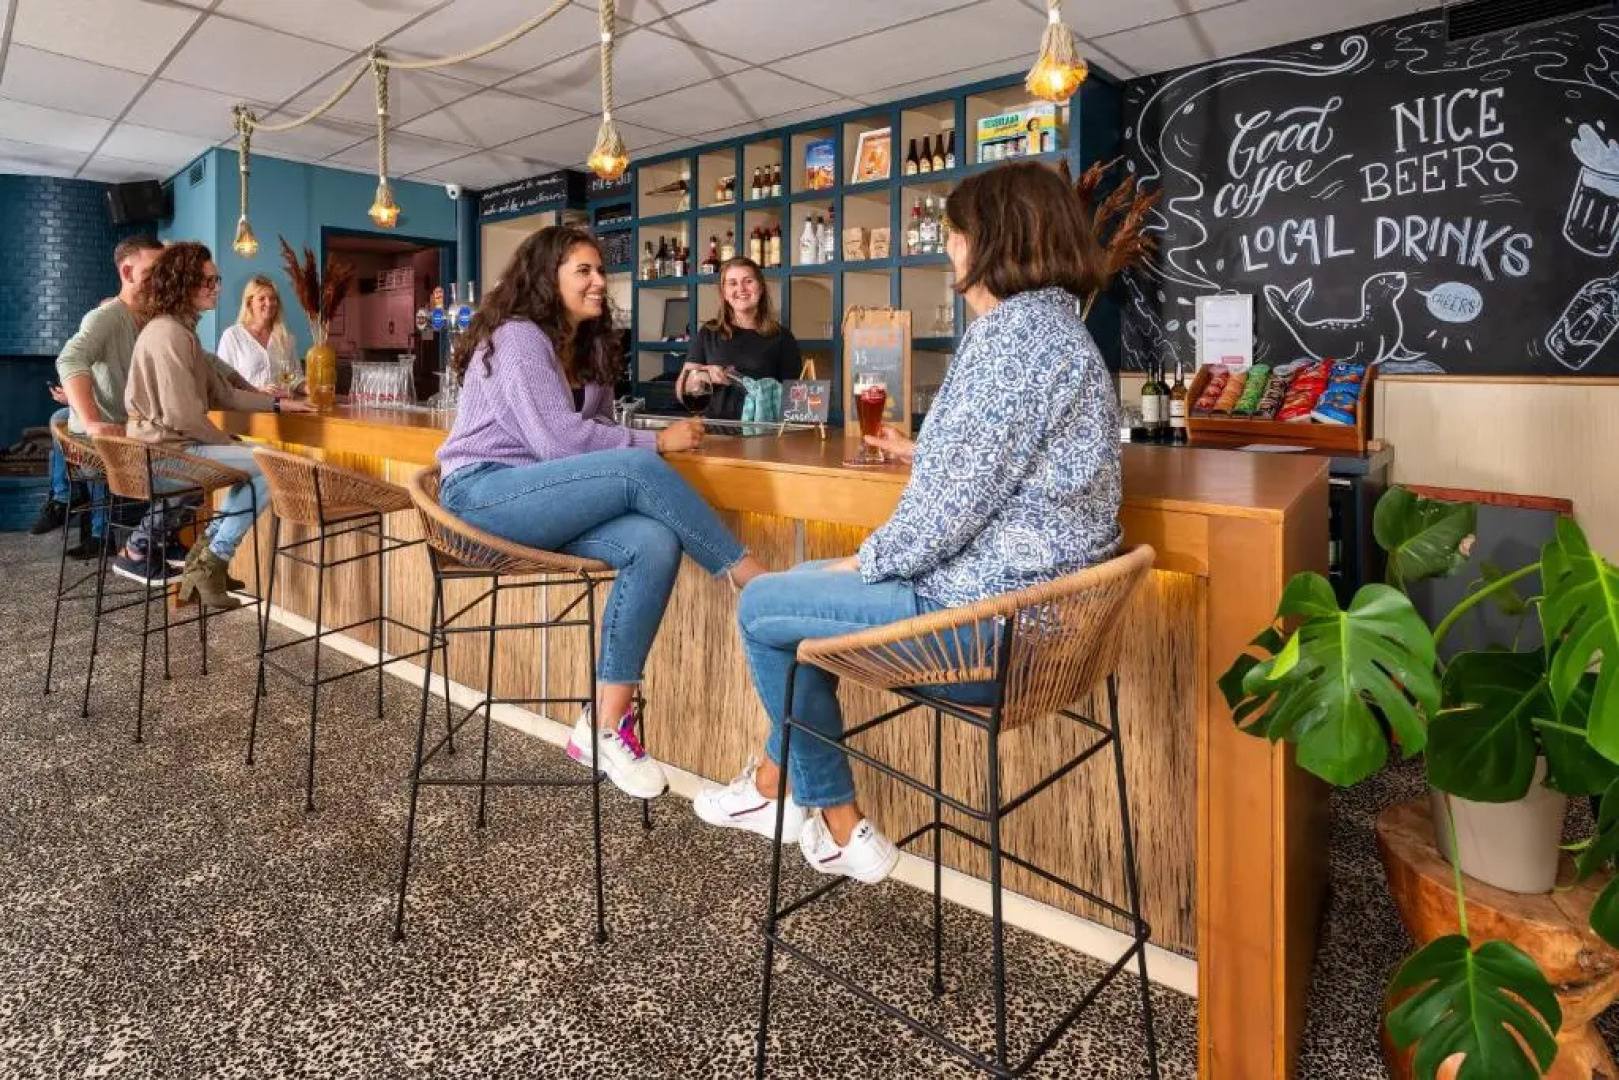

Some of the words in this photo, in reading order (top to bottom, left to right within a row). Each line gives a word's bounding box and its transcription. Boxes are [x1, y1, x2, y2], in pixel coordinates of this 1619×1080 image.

[1228, 96, 1342, 179] Good
[1391, 87, 1504, 152] NICE
[1213, 159, 1353, 218] coffee
[1359, 142, 1518, 203] BEERS
[1239, 214, 1355, 272] LOCAL
[1374, 214, 1533, 281] DRINKS
